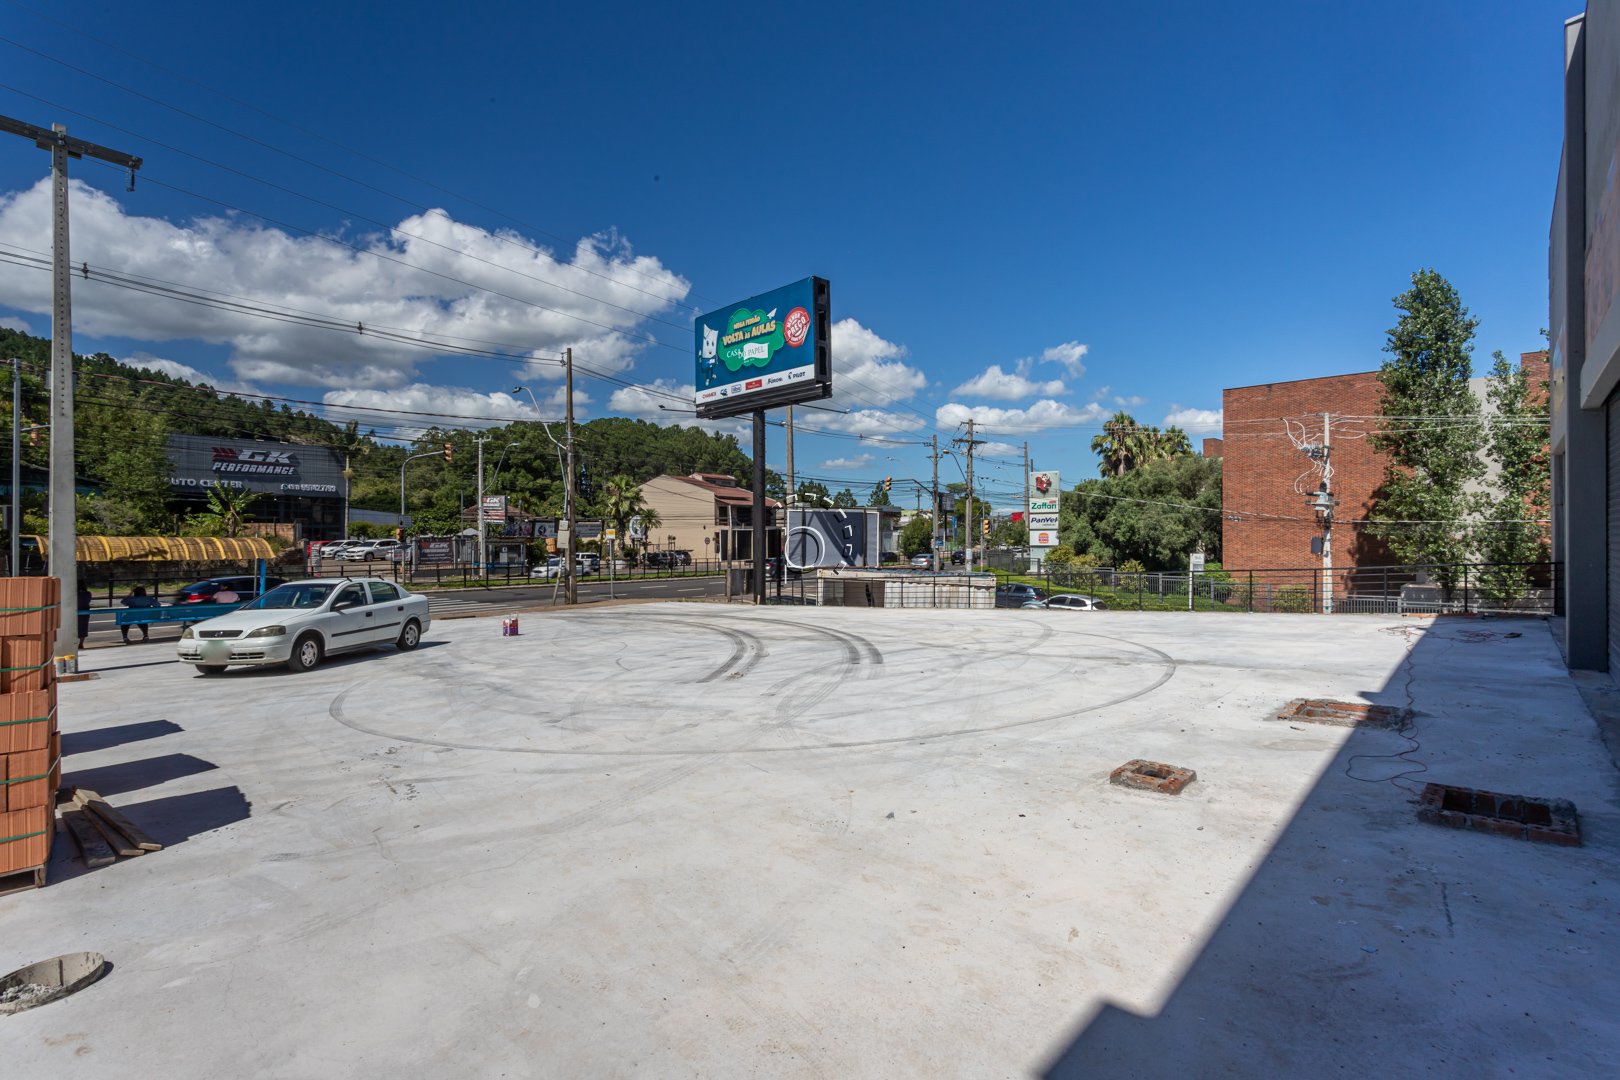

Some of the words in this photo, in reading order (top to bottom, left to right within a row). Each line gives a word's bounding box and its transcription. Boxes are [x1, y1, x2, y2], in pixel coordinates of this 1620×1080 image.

[722, 330, 744, 346] VOLTA
[751, 320, 776, 337] AULAS
[747, 346, 765, 356] PAPEL
[792, 371, 806, 379] PILOT
[212, 462, 295, 475] PERFORMANCE
[200, 479, 243, 488] CETER
[1031, 502, 1057, 510] Zaffari
